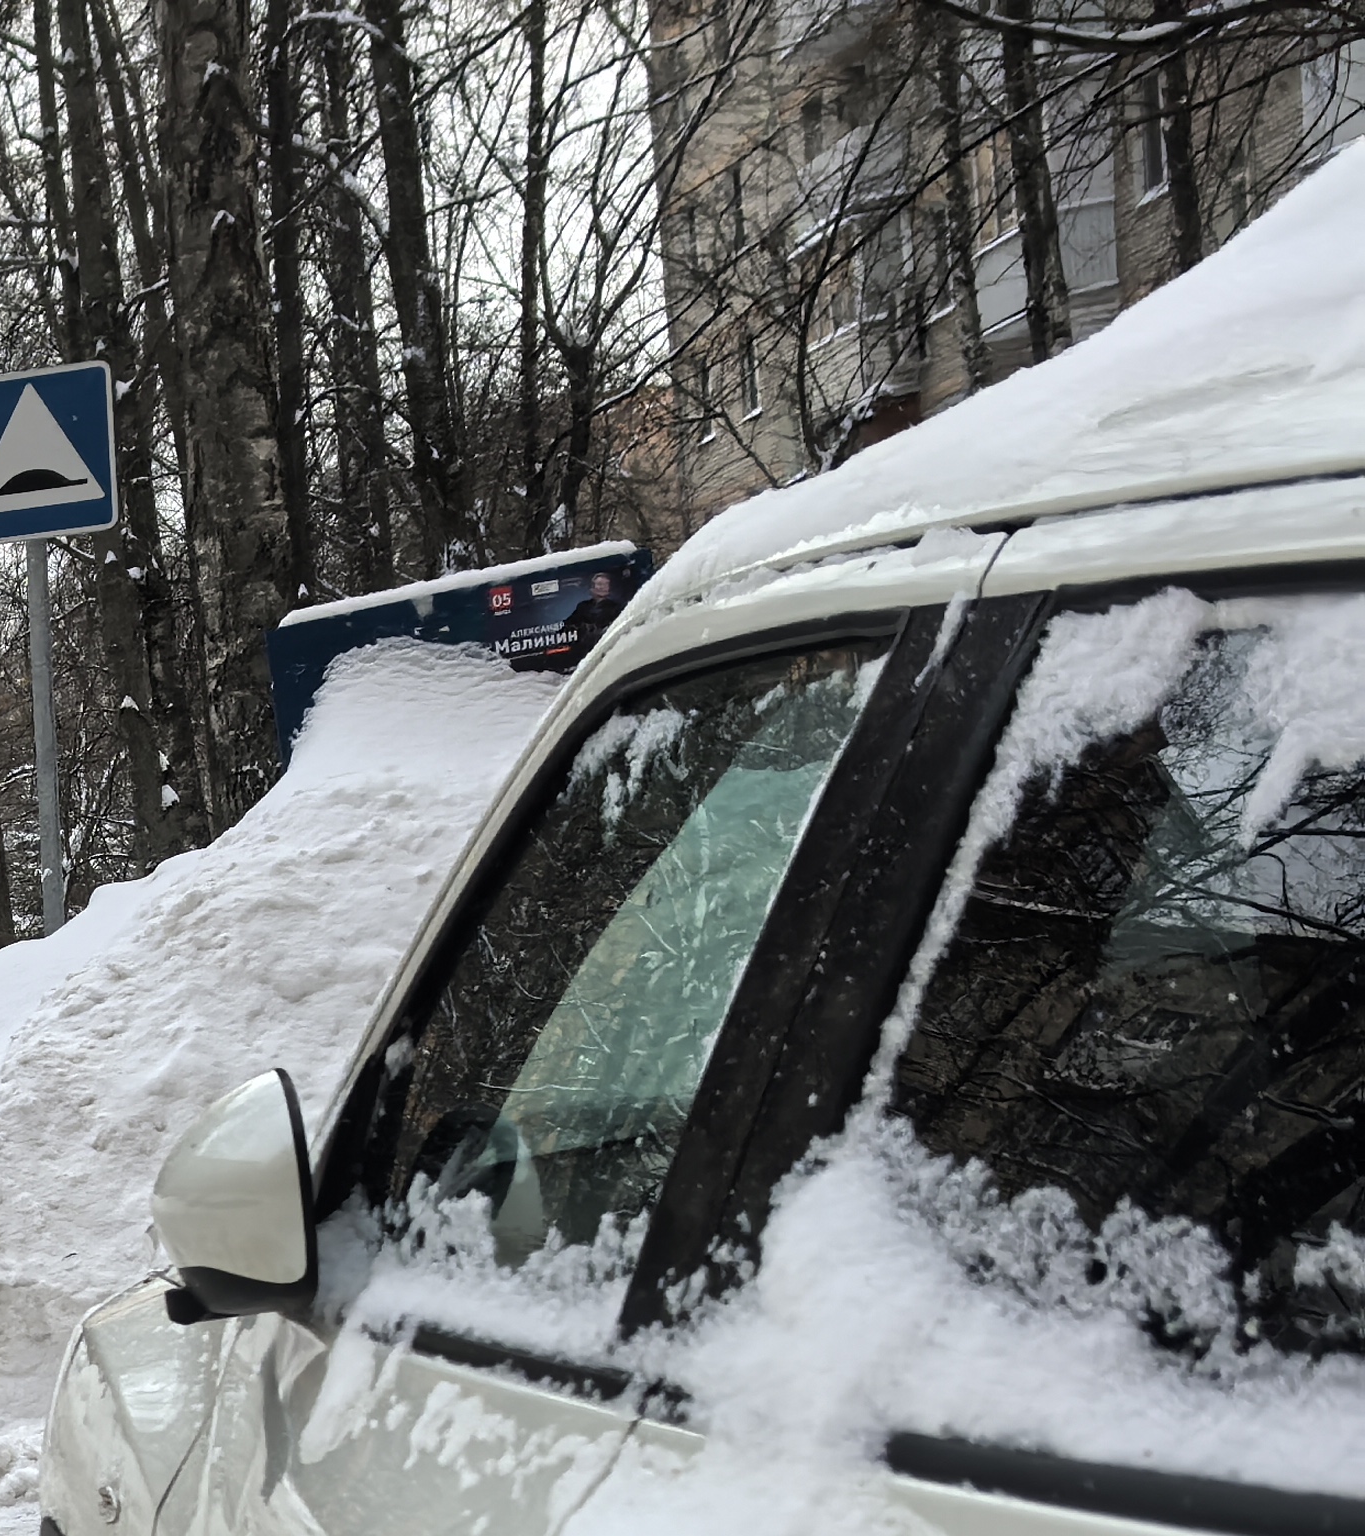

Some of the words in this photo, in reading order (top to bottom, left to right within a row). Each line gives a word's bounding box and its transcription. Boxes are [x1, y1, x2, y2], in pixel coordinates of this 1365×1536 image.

[492, 593, 511, 608] 05
[510, 622, 565, 639] АЛЕКСАНДР
[495, 630, 578, 654] Малинин
